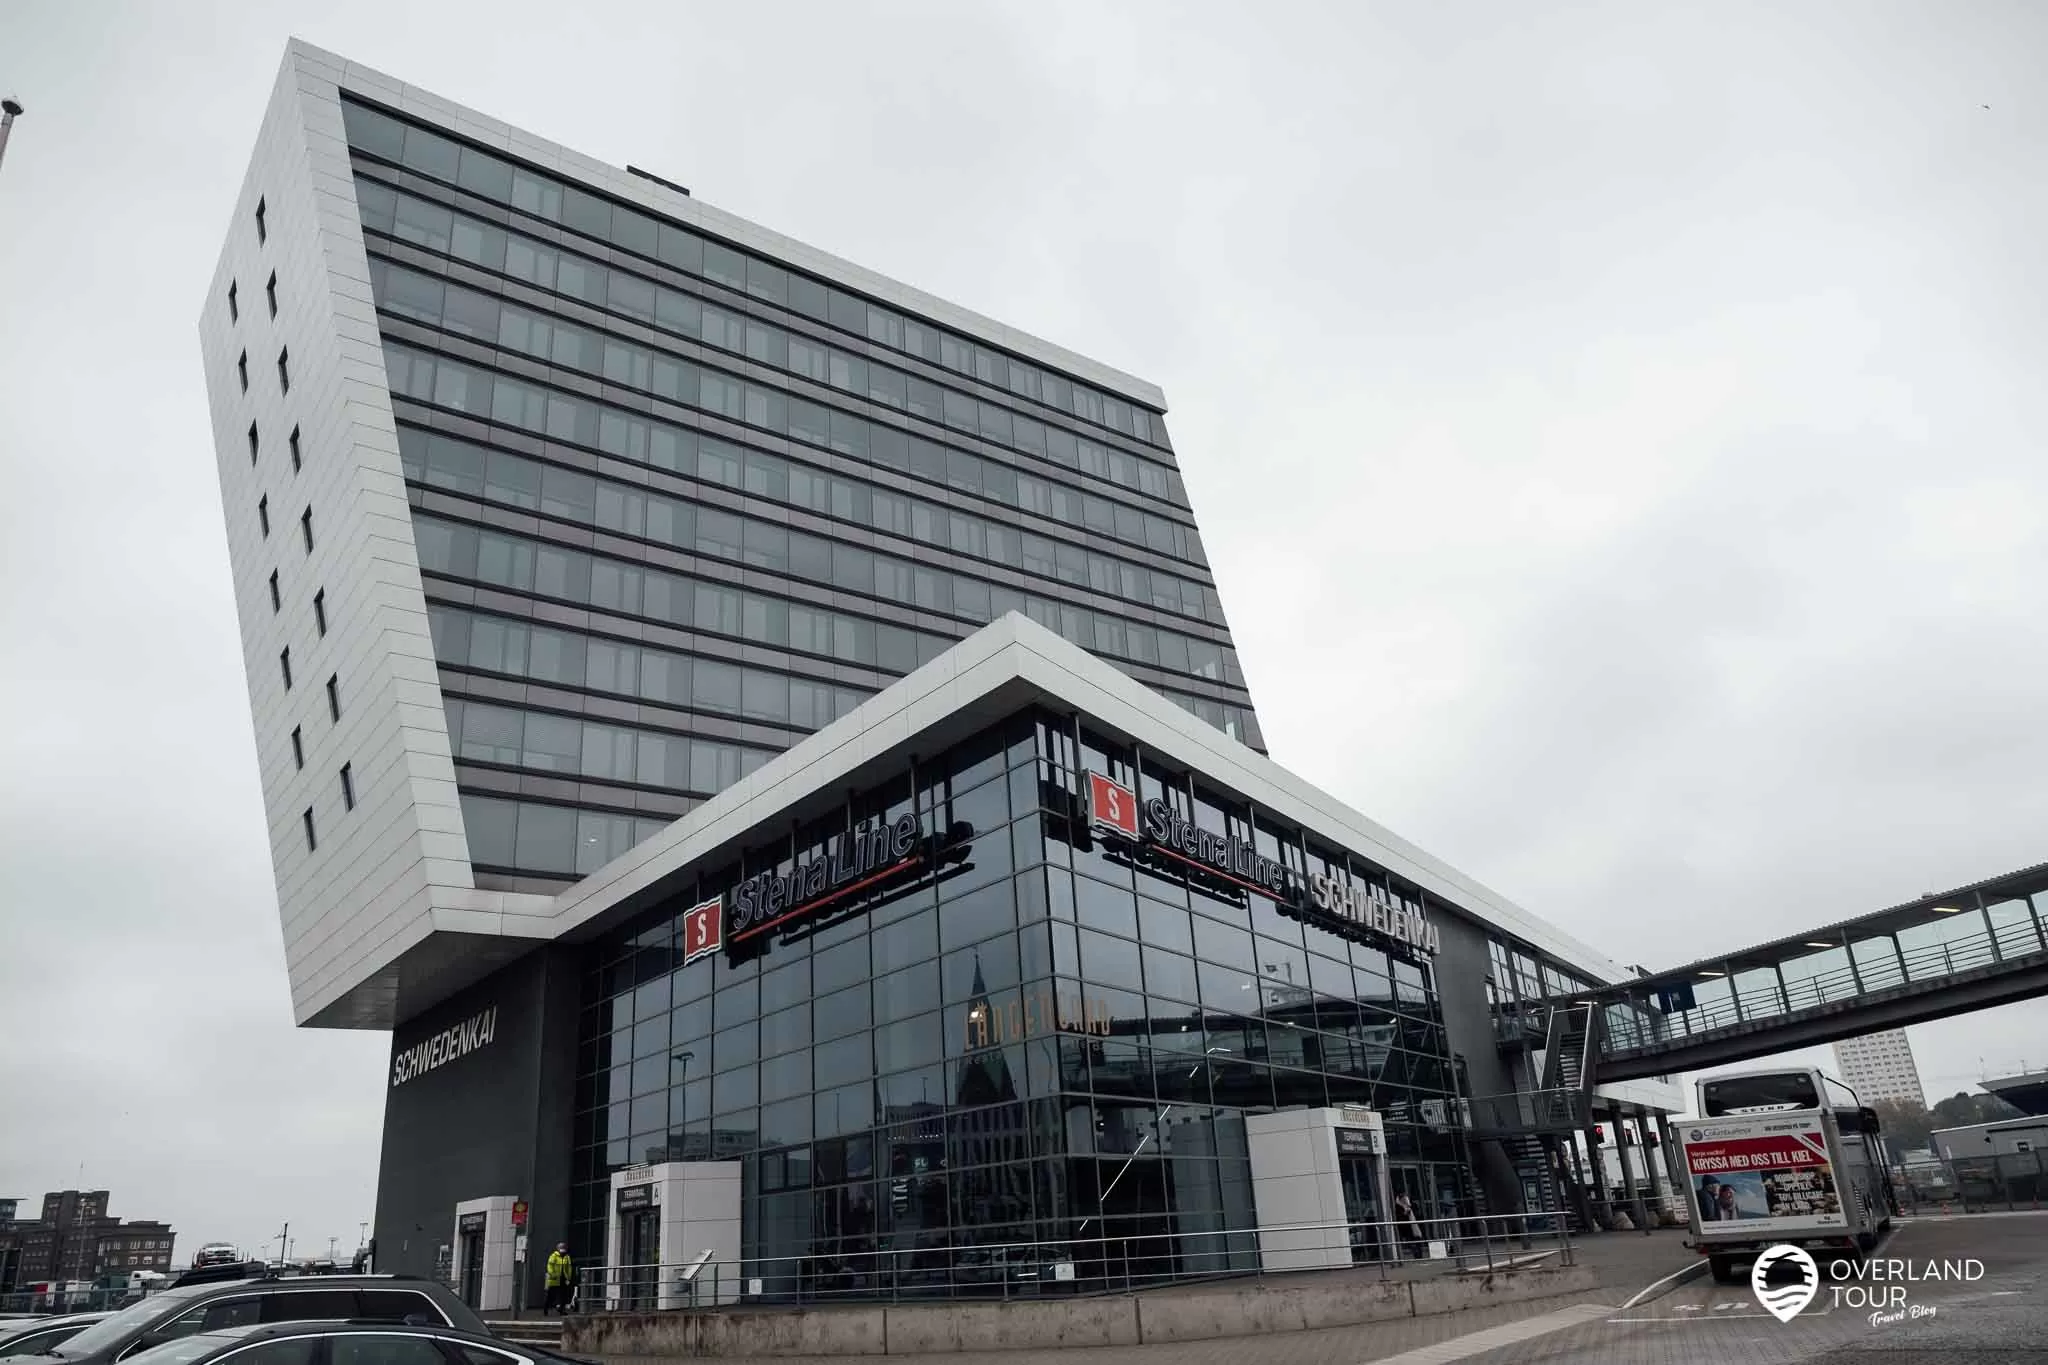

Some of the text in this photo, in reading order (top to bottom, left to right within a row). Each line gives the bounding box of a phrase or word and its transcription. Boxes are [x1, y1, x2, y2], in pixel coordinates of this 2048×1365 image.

[1107, 788, 1121, 822] S
[697, 912, 708, 946] S
[1312, 872, 1441, 954] SCHWEDENKAI
[393, 1005, 498, 1087] SCHWEDENKAI
[1692, 1149, 1813, 1171] KRYSSA MED OSS TILL KIEL
